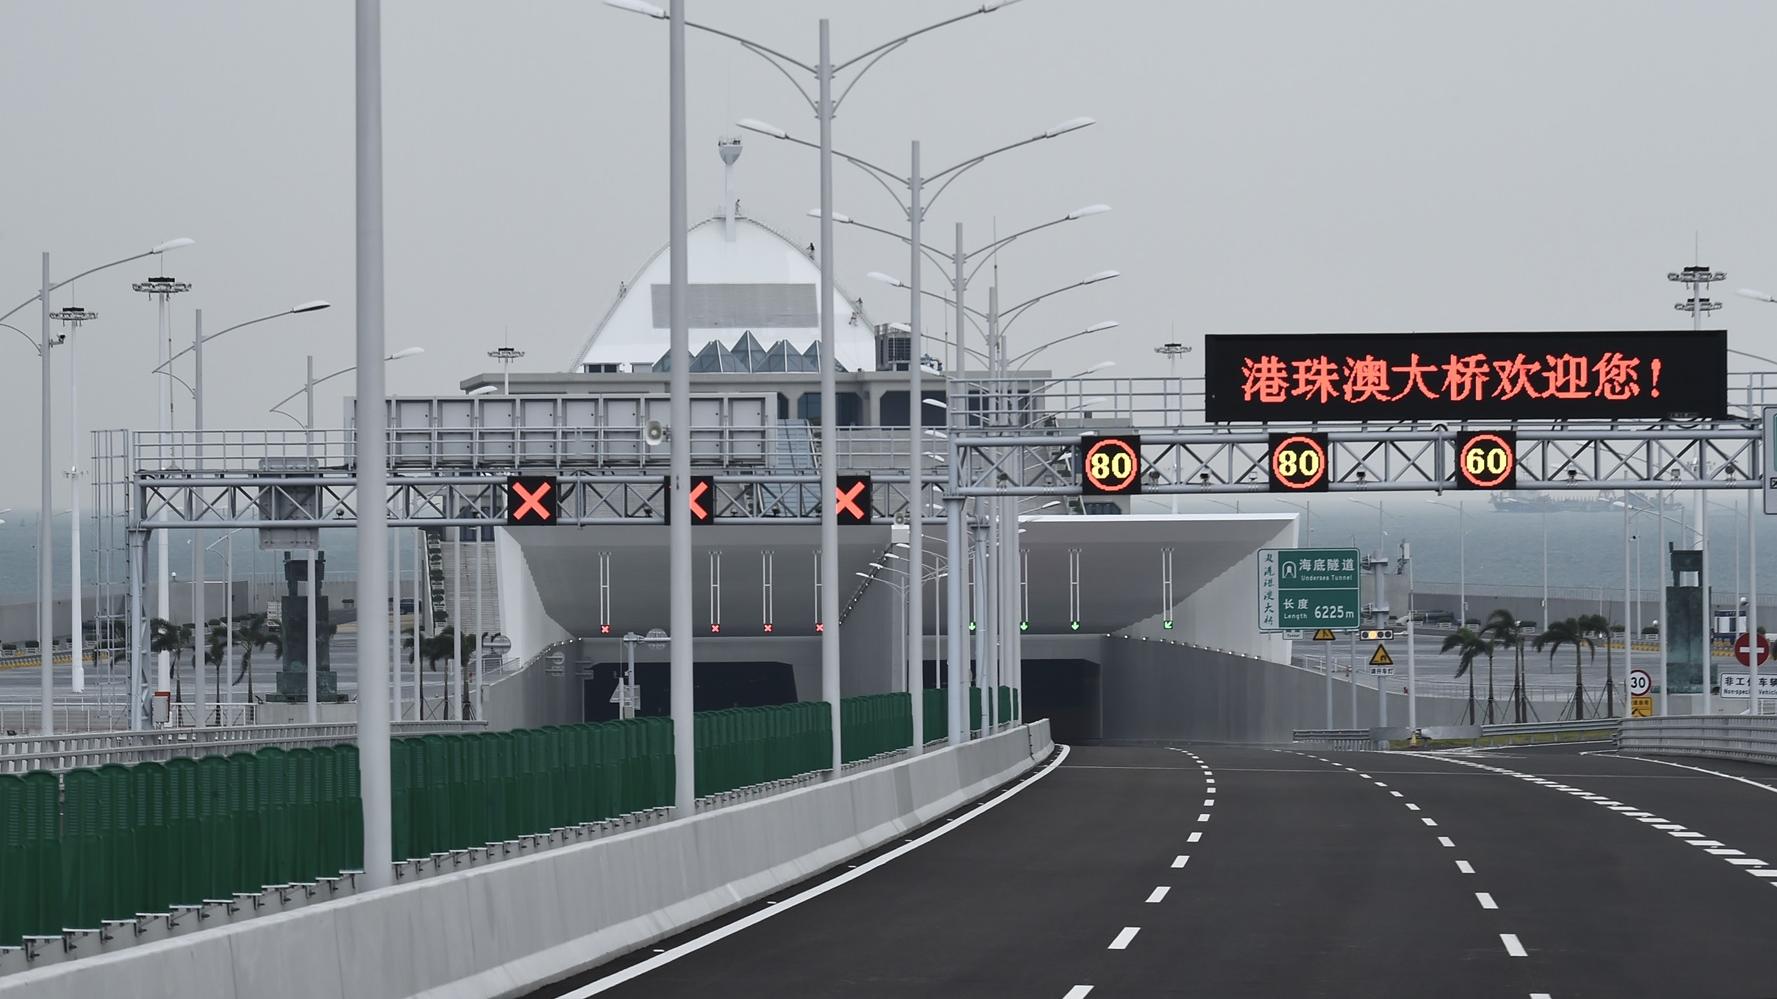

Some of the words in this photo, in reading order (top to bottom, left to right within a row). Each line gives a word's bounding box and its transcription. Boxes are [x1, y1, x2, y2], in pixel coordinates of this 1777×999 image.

[1241, 352, 1662, 404] 港珠澳大桥欢迎您!
[1090, 452, 1133, 479] 80
[1278, 450, 1320, 477] 80
[1466, 448, 1508, 475] 60
[1299, 558, 1355, 572] 海底隧道
[1283, 598, 1309, 610] 长度
[1283, 613, 1308, 621] Length
[1314, 605, 1344, 619] 6225
[1631, 677, 1646, 689] 30
